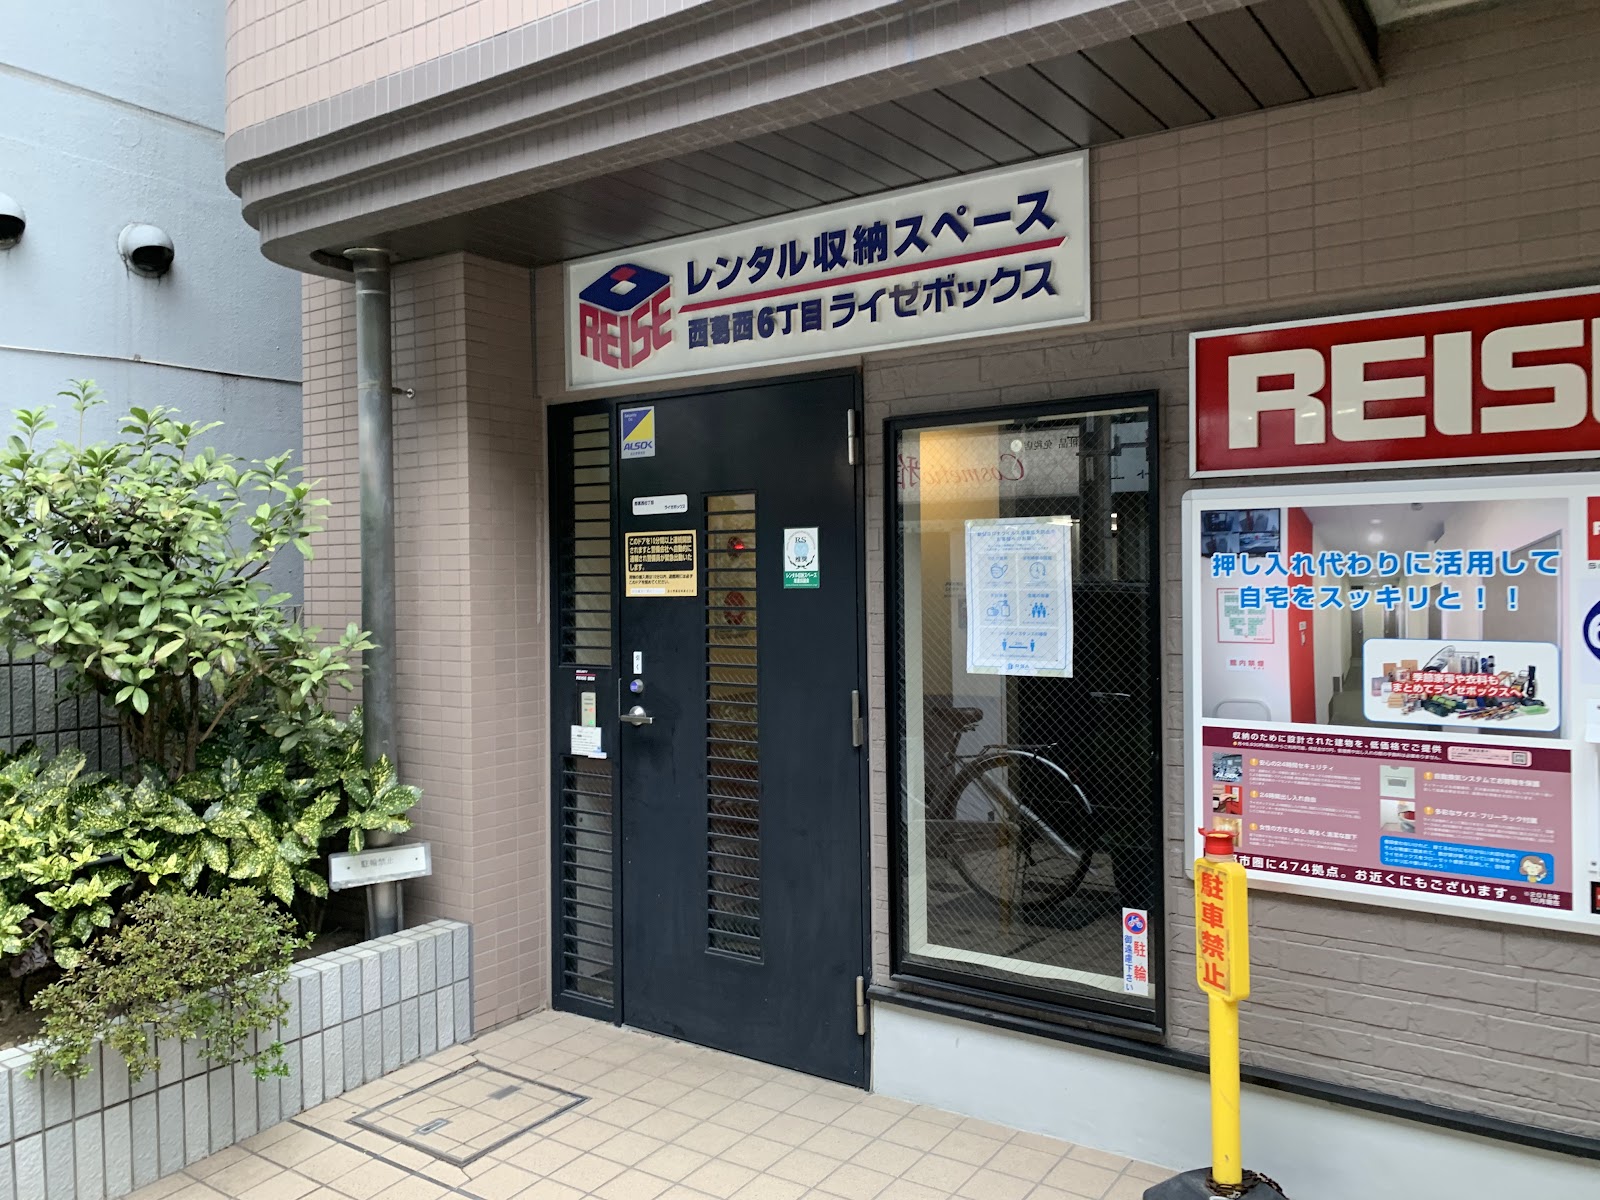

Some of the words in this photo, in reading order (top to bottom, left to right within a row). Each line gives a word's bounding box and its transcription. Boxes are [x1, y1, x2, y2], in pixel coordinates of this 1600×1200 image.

[687, 189, 1058, 296] レンタル収納スペース
[579, 286, 672, 370] REISE
[1228, 318, 1600, 450] REIS
[623, 441, 653, 451] ALSOK
[1212, 549, 1561, 577] 押し入れ代わりに活用して
[1239, 585, 1520, 611] 自宅をスッキリと！！
[1133, 941, 1147, 983] 駐輪
[1201, 871, 1226, 991] 駐車禁止
